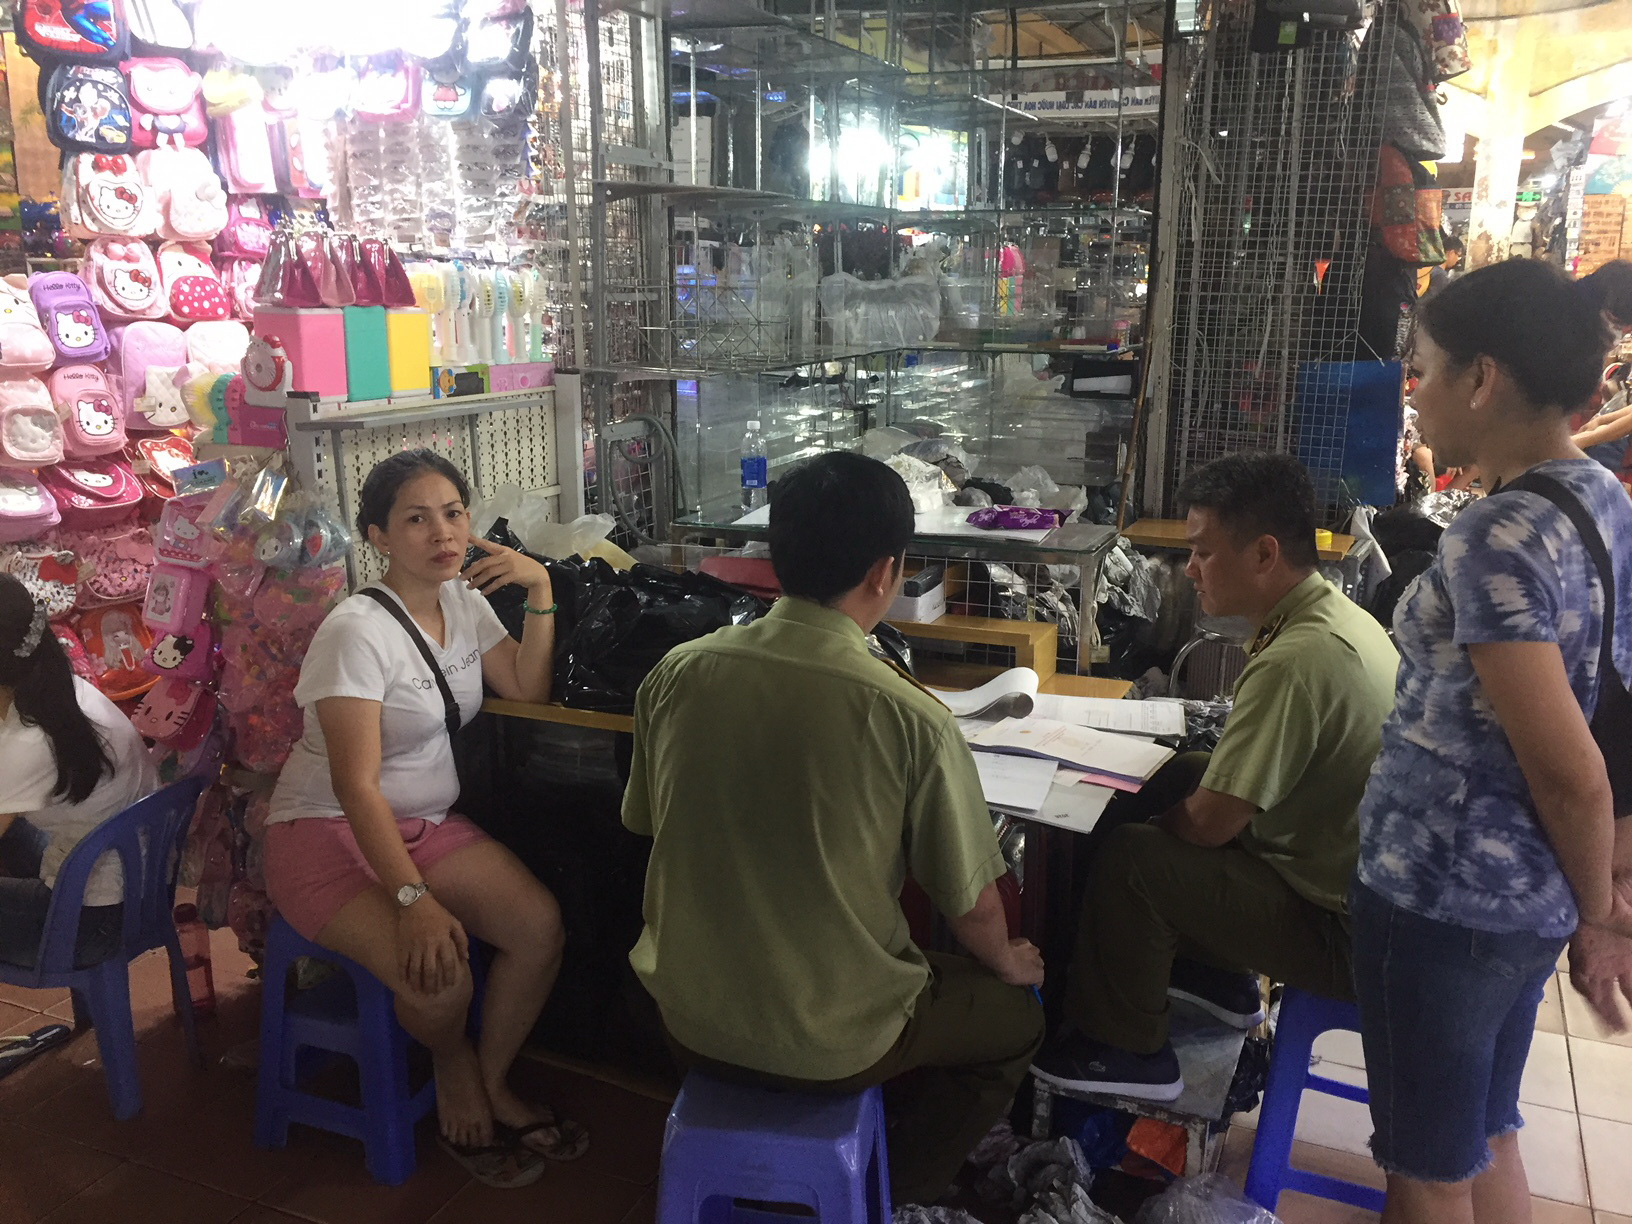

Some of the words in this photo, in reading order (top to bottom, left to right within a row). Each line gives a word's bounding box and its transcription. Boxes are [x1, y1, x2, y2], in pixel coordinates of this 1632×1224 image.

[43, 283, 64, 291] Hello
[65, 283, 81, 292] Kitty
[85, 373, 99, 382] Kitty
